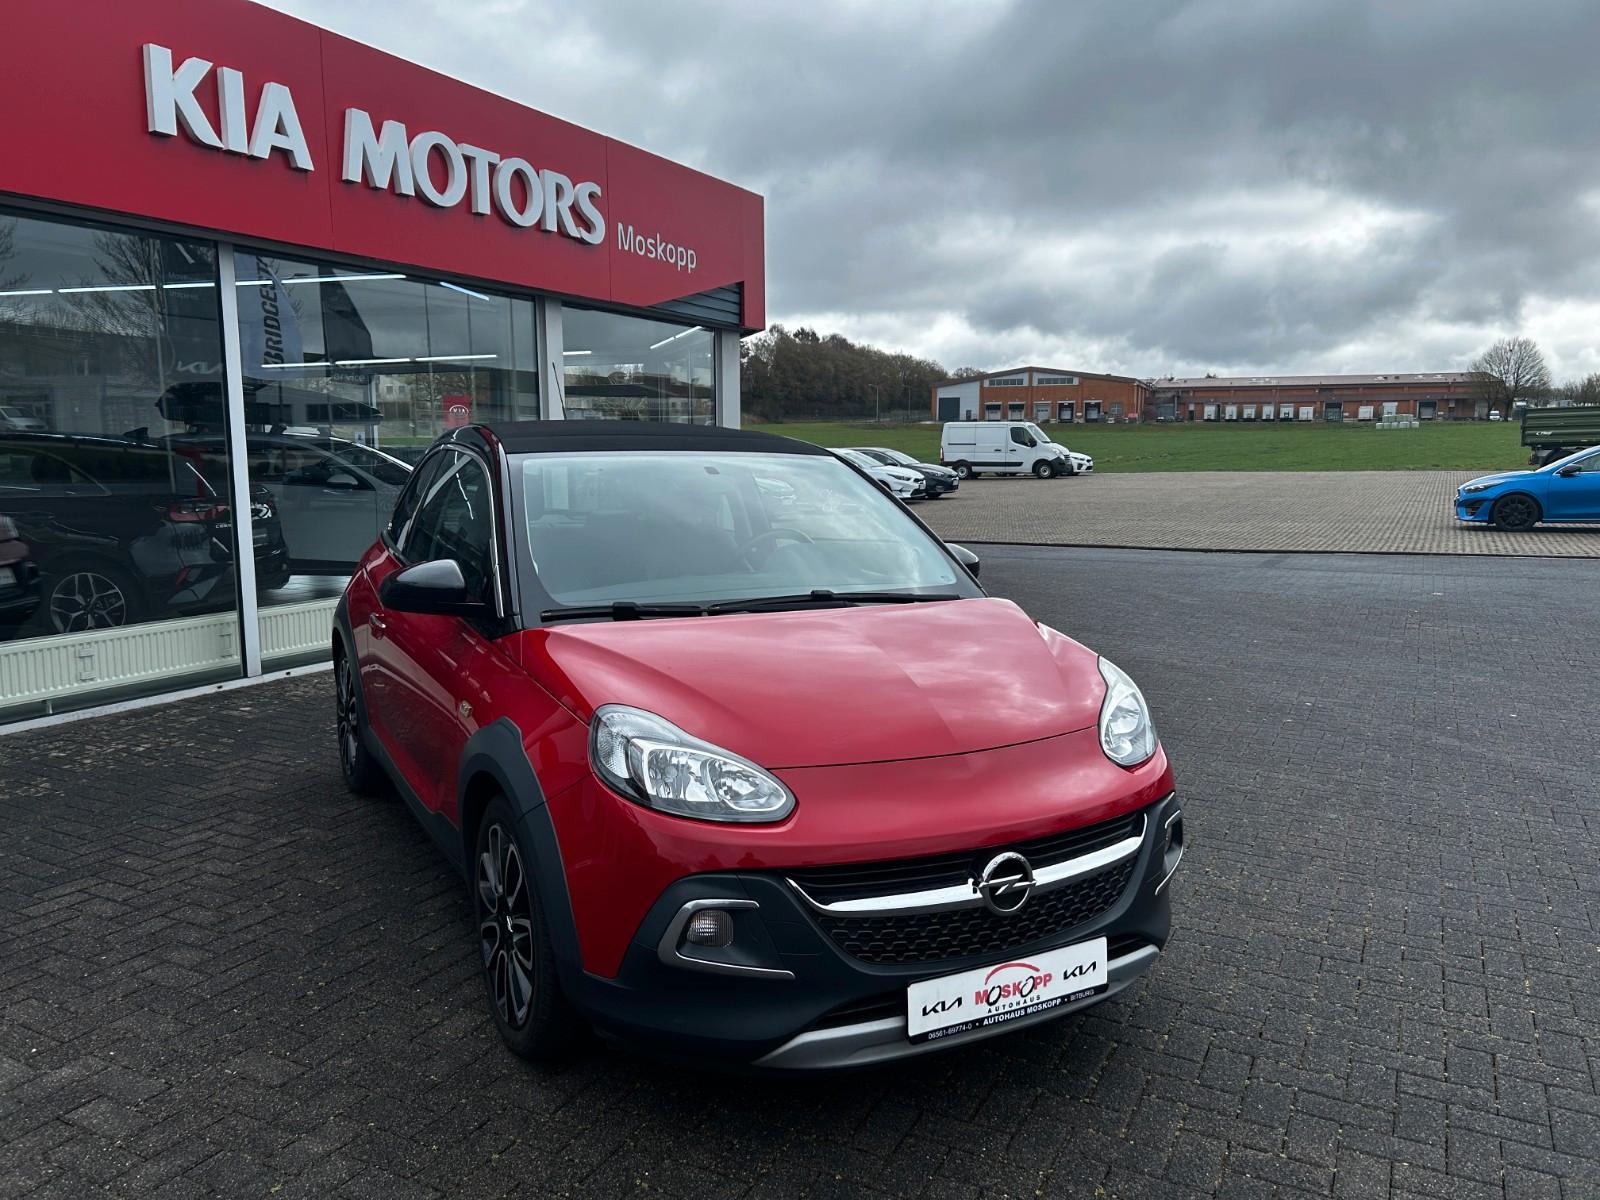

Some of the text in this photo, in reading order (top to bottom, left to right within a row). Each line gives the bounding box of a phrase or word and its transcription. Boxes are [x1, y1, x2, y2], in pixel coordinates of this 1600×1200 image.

[143, 43, 606, 245] KIA MOTORS
[618, 222, 697, 274] Moskopp
[1063, 961, 1097, 980] KIA
[975, 973, 1053, 1006] MOSKOPP
[988, 994, 1041, 1014] AUTOHAUS
[922, 996, 962, 1017] KIA
[983, 1008, 1025, 1026] AUTOHAUS
[1027, 998, 1061, 1014] MOSKOPP
[1070, 988, 1095, 1001] BITBURG
